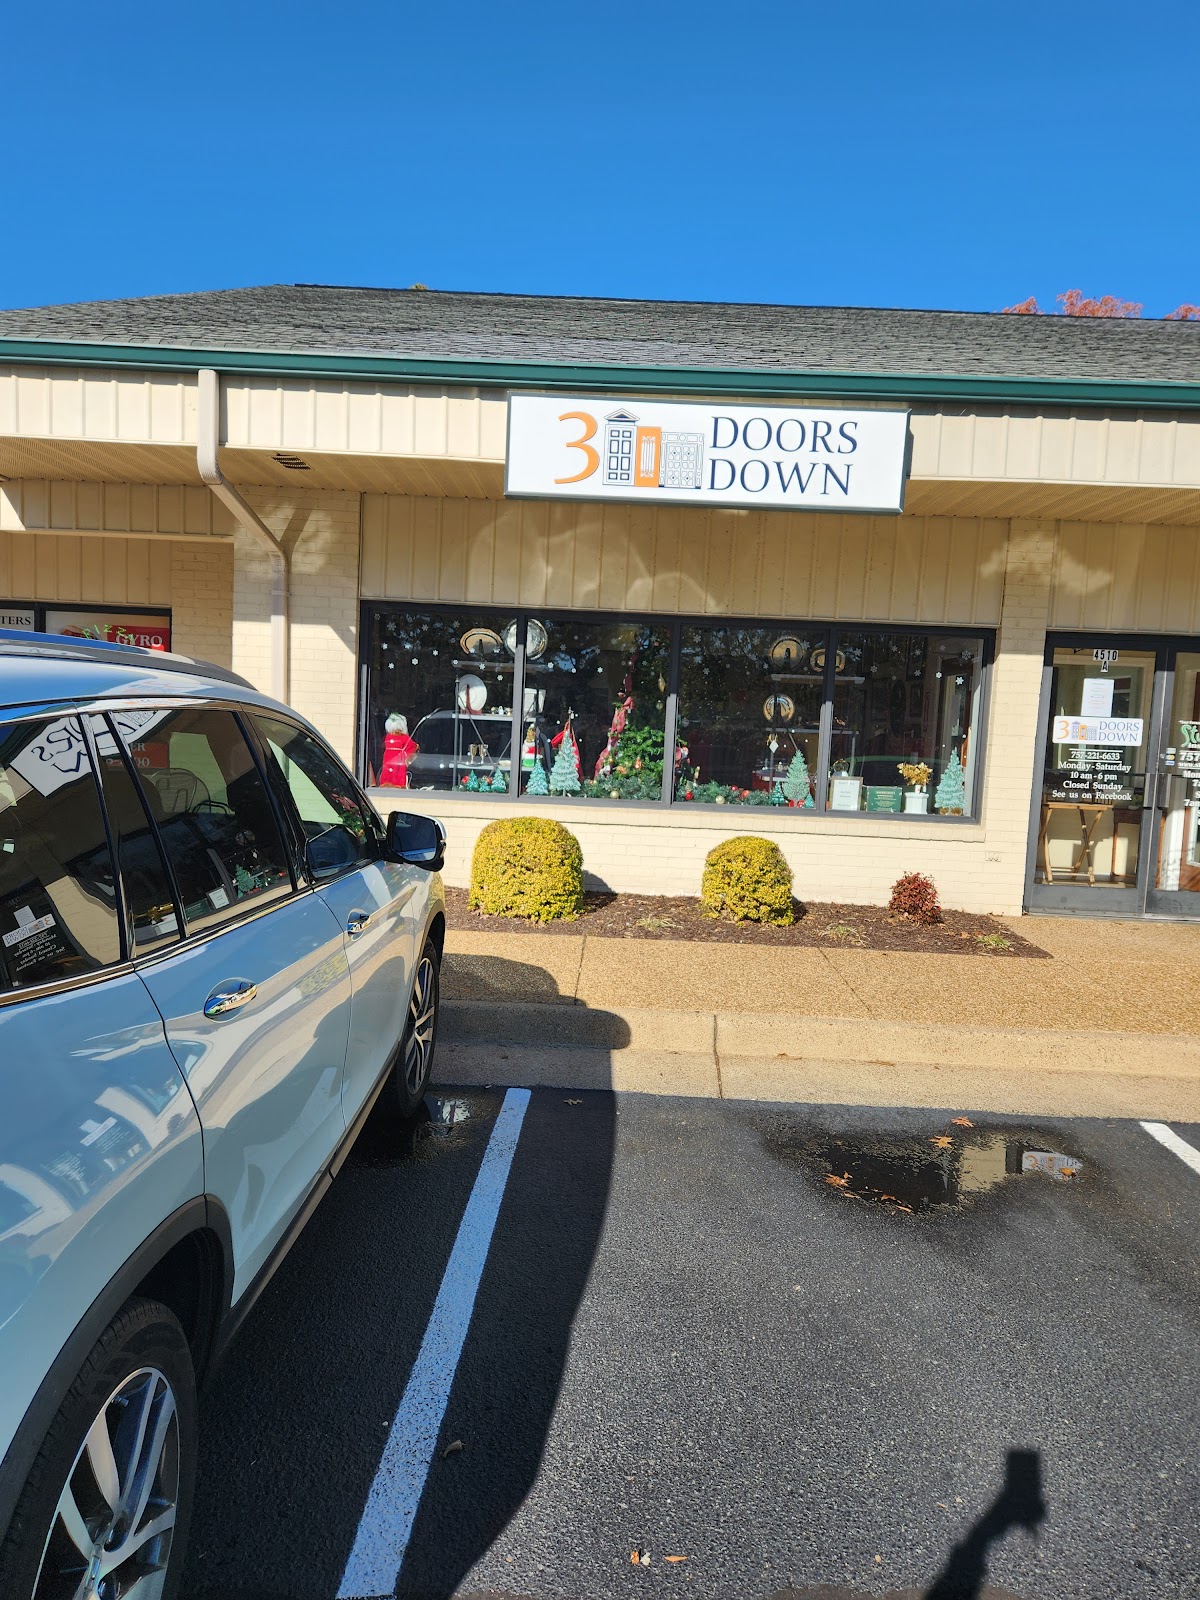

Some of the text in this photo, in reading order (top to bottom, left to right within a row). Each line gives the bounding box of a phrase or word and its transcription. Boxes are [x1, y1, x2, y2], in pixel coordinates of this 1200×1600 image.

[708, 415, 859, 455] DOORS
[553, 411, 600, 485] 3
[706, 456, 854, 497] DOWN
[115, 633, 163, 647] GYRO
[1093, 649, 1118, 660] 4510
[1102, 660, 1108, 671] A
[1056, 720, 1070, 740] 3
[1100, 721, 1140, 732] DOORS
[1098, 732, 1138, 742] DOWN
[1070, 751, 1120, 760] 757-221-6633
[1070, 771, 1079, 779] 10
[1062, 780, 1124, 792] Closed Sunday
[1096, 792, 1132, 800] Facebook
